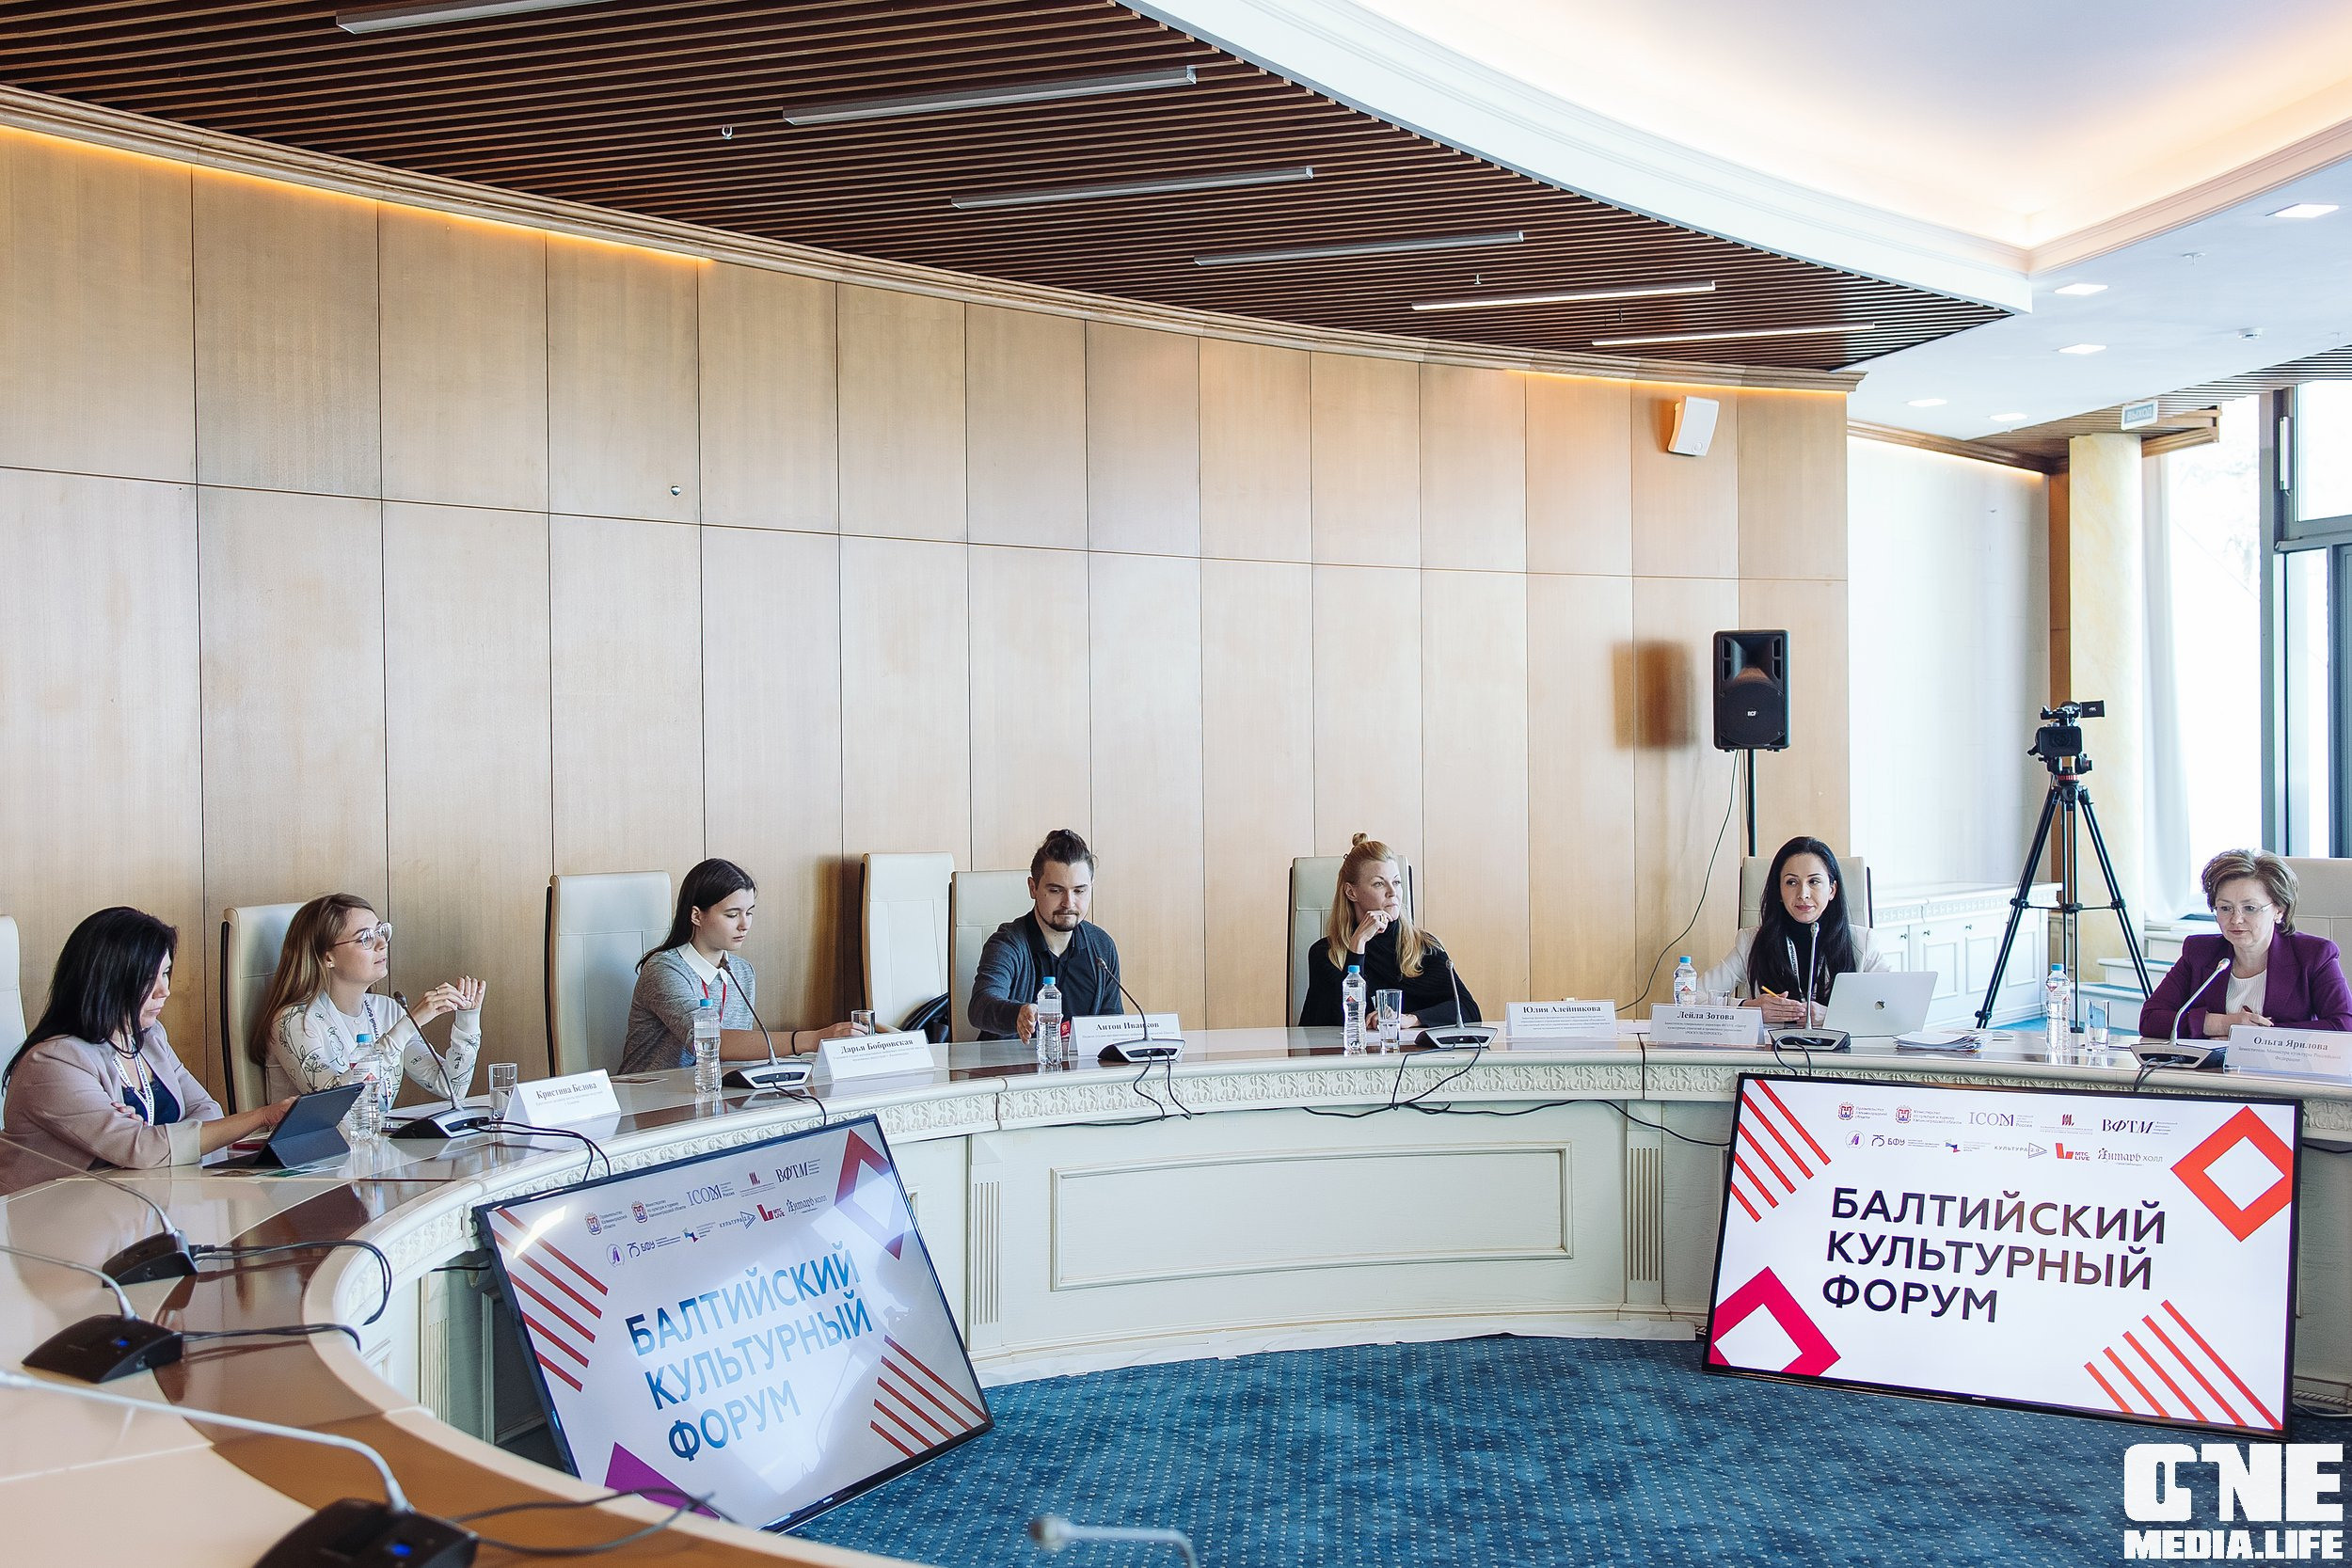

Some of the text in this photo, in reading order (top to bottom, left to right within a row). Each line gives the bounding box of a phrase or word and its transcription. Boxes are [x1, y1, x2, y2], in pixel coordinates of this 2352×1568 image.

[1550, 1005, 1601, 1014] Алейникова
[1677, 1011, 1735, 1021] Лейла Зотова
[1096, 1022, 1121, 1031] Антон
[841, 1045, 866, 1054] Дарья
[866, 1038, 914, 1052] Бобровская
[2253, 1037, 2328, 1051] Ольга Ярилова
[535, 1086, 573, 1101] Кристина
[572, 1082, 597, 1095] Белова
[1969, 1111, 2014, 1127] ICOM
[2103, 1118, 2153, 1134] ВФТМ
[1887, 1137, 1905, 1146] БФУ
[775, 1162, 809, 1183] ВФТМ
[686, 1184, 722, 1206] ICOM
[720, 1218, 743, 1228] КУЛЬТУРА
[1832, 1187, 2165, 1243] БАЛТИЙСКИЙ
[641, 1240, 656, 1252] БФУ
[1827, 1230, 2152, 1291] КУЛЬТУРНЫЙ
[626, 1241, 861, 1356] БАЛТИЙСКИЙ
[1822, 1275, 1997, 1323] ФОРУМ
[644, 1289, 873, 1411] КУЛЬТУРНЫЙ
[669, 1380, 801, 1462] ФОРУМ
